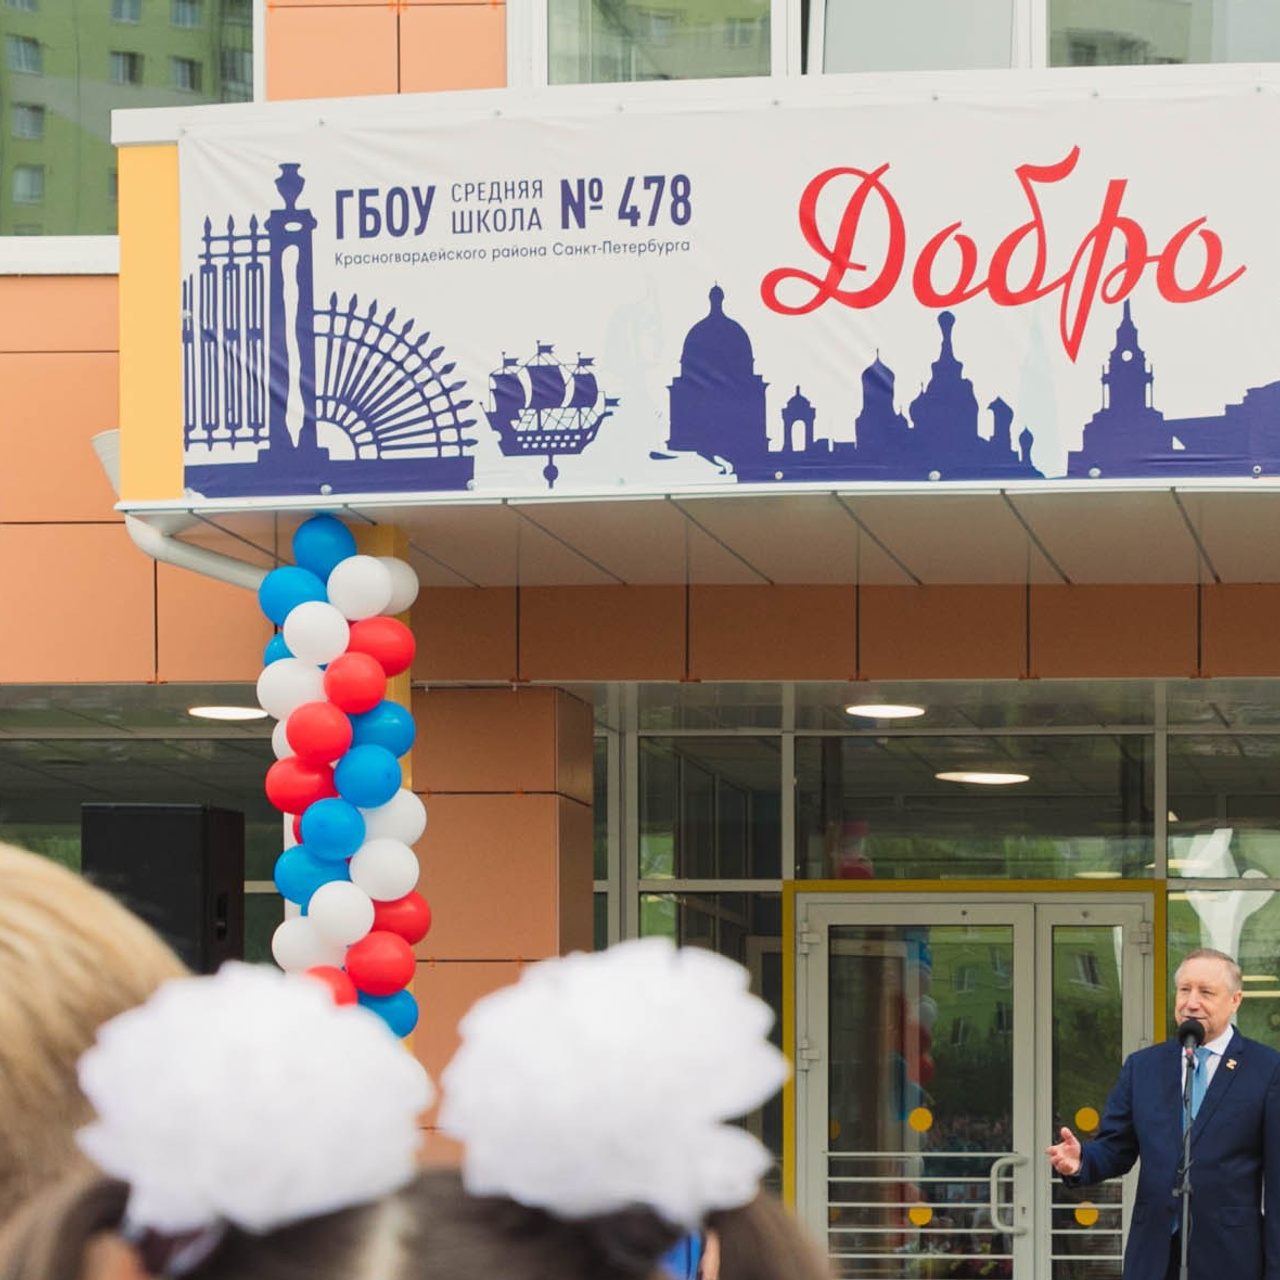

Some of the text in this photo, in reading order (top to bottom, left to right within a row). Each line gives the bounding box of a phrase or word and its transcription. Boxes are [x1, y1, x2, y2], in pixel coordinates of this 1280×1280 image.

[336, 185, 436, 240] ГБОУ
[451, 179, 543, 204] СРЕДНЯЯ
[560, 174, 691, 229] № 478
[451, 207, 543, 234] ШКОЛА
[335, 238, 691, 268] Красногвардейского района Санкт-Петербурга
[760, 146, 1246, 363] Добро
